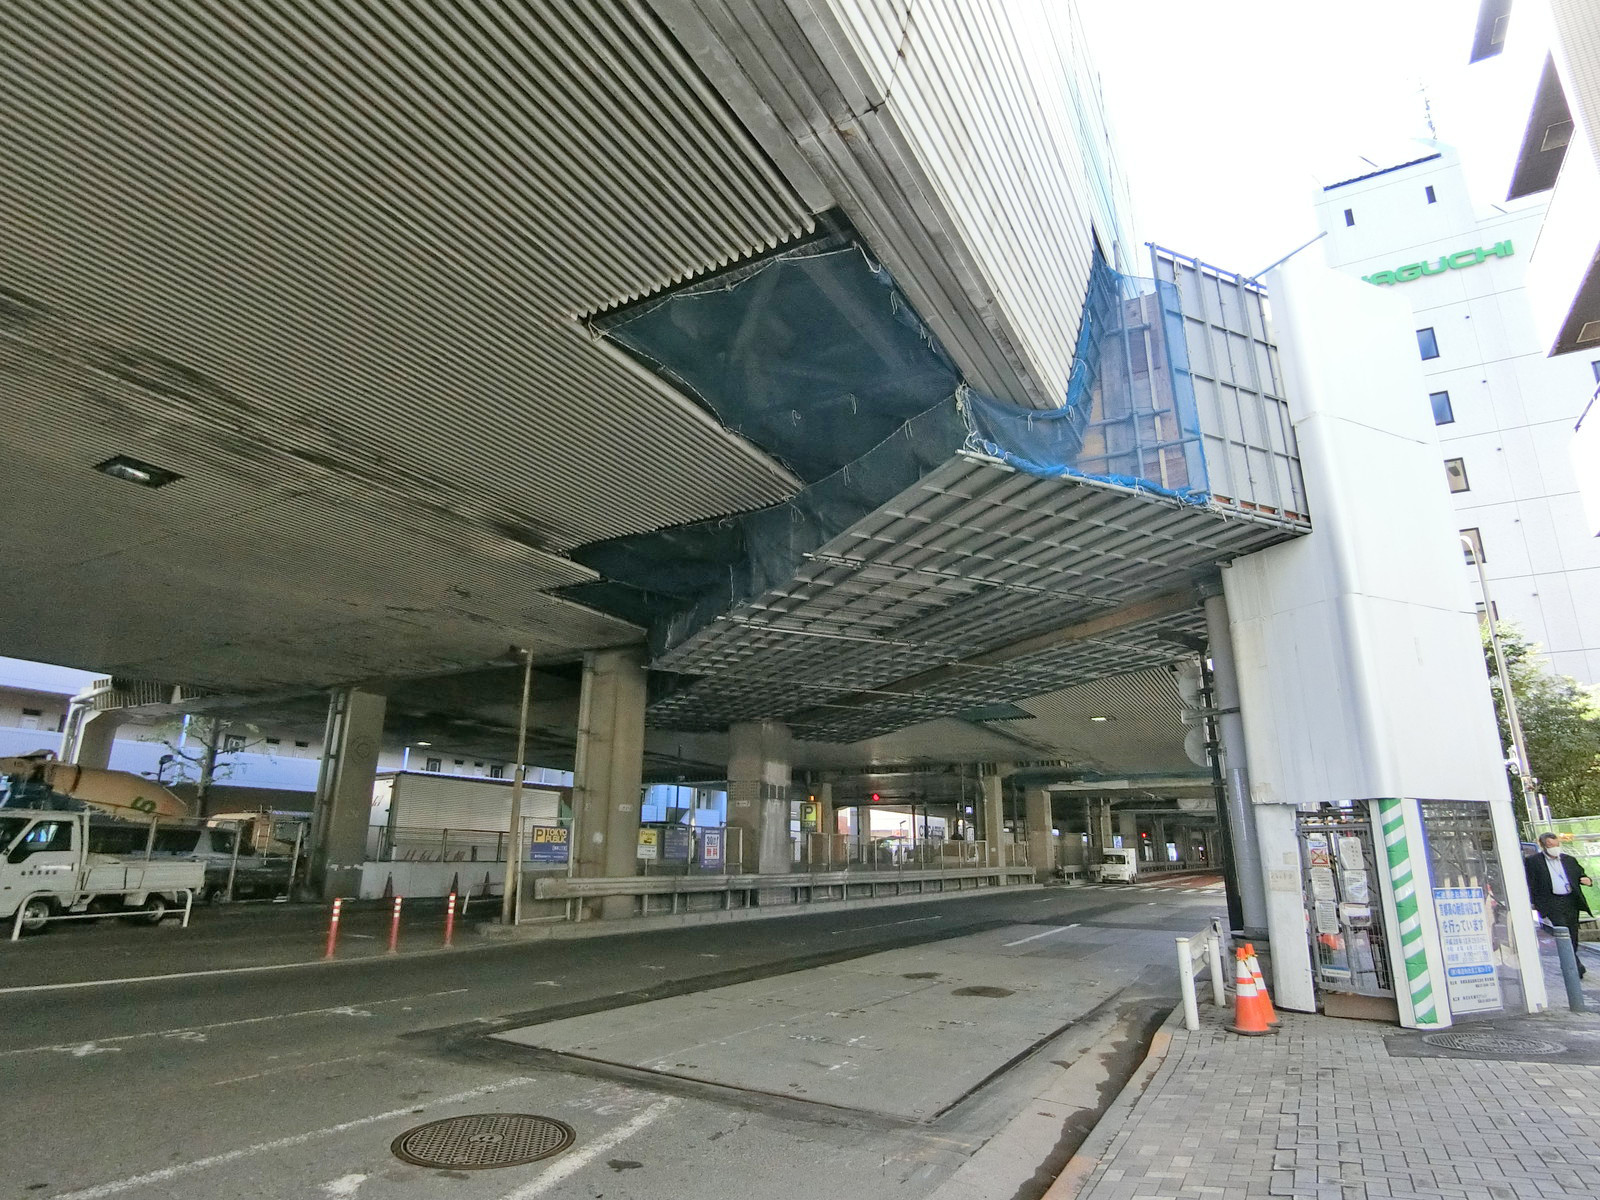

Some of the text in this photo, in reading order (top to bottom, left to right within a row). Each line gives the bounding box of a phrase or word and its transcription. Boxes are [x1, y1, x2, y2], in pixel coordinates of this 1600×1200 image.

[1361, 239, 1515, 286] AGUCHI
[546, 827, 568, 836] TOKYO
[545, 835, 567, 843] PUBLIC
[1443, 919, 1484, 933] を行っています
